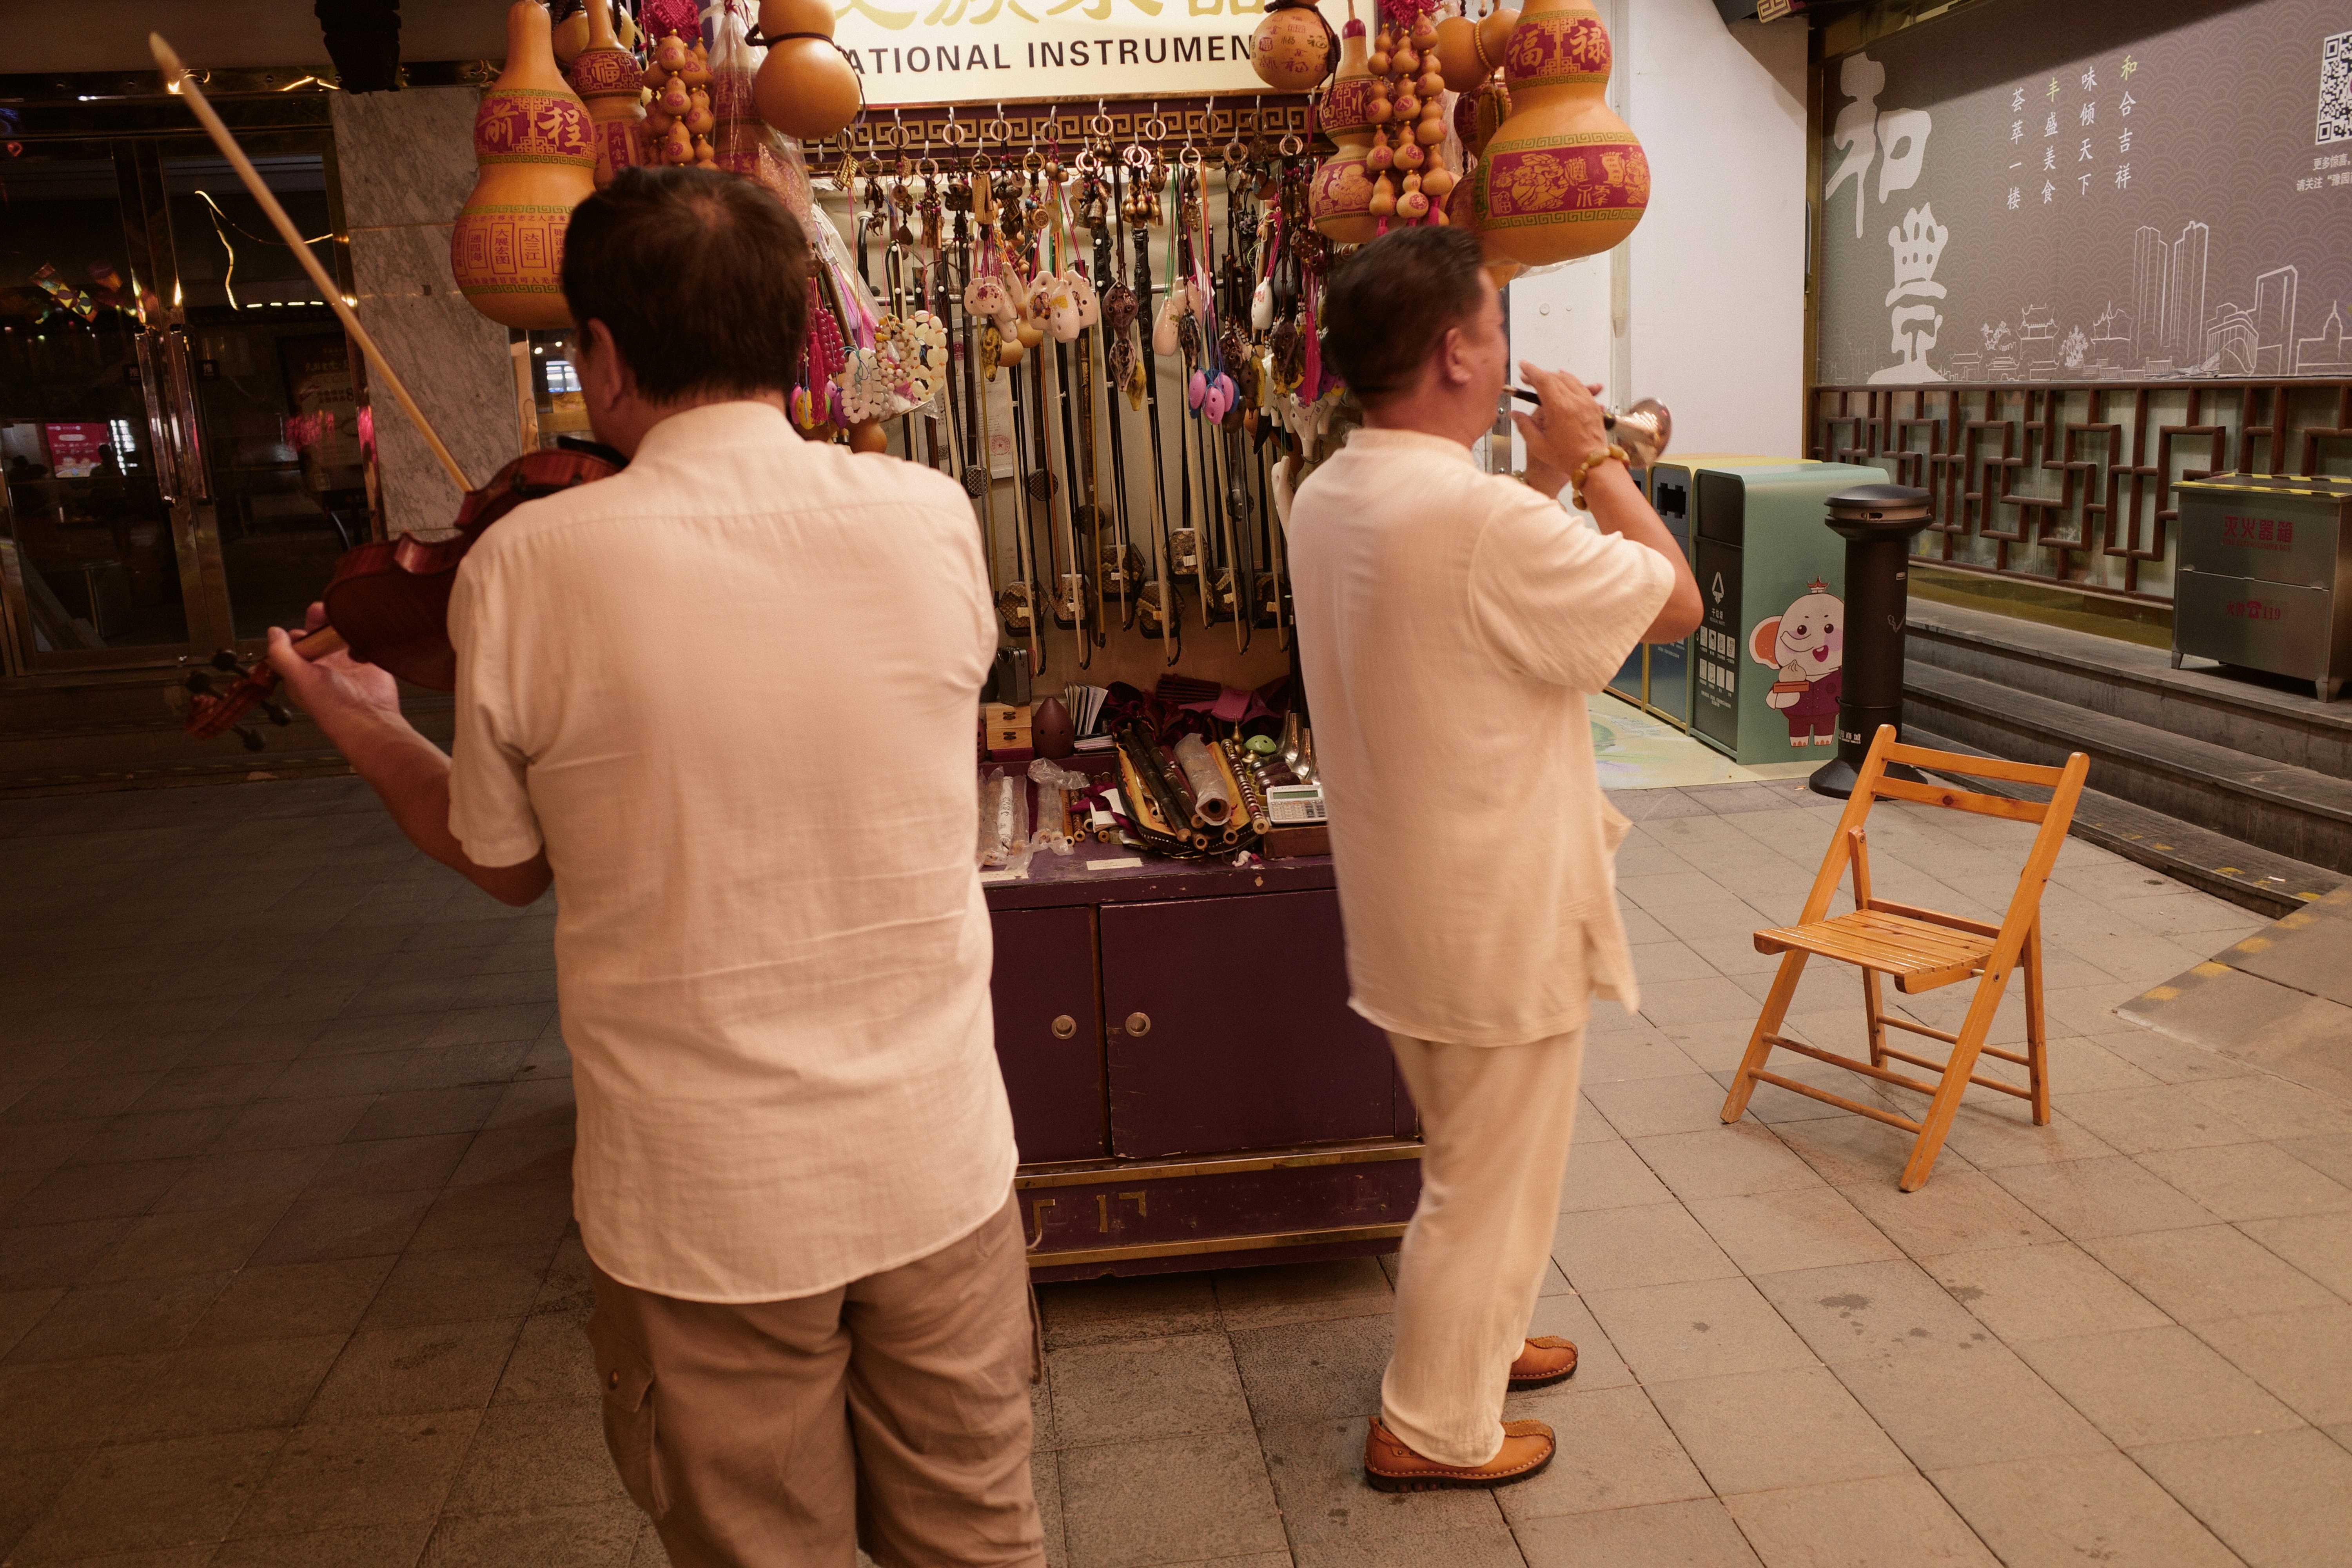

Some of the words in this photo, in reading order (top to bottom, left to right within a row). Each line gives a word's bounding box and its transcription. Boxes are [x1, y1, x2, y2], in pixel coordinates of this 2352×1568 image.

[1028, 34, 1252, 67] INSTRUMEN
[2078, 66, 2098, 196] 味倾天下
[2115, 54, 2138, 189] 和合吉祥
[2006, 87, 2025, 210] 荟萃一楼
[2041, 77, 2060, 204] 丰盛美食
[494, 228, 510, 265] 大展宏图
[523, 232, 541, 261] 达三江
[2223, 515, 2293, 543] 灭火器箱
[2263, 606, 2281, 621] 119
